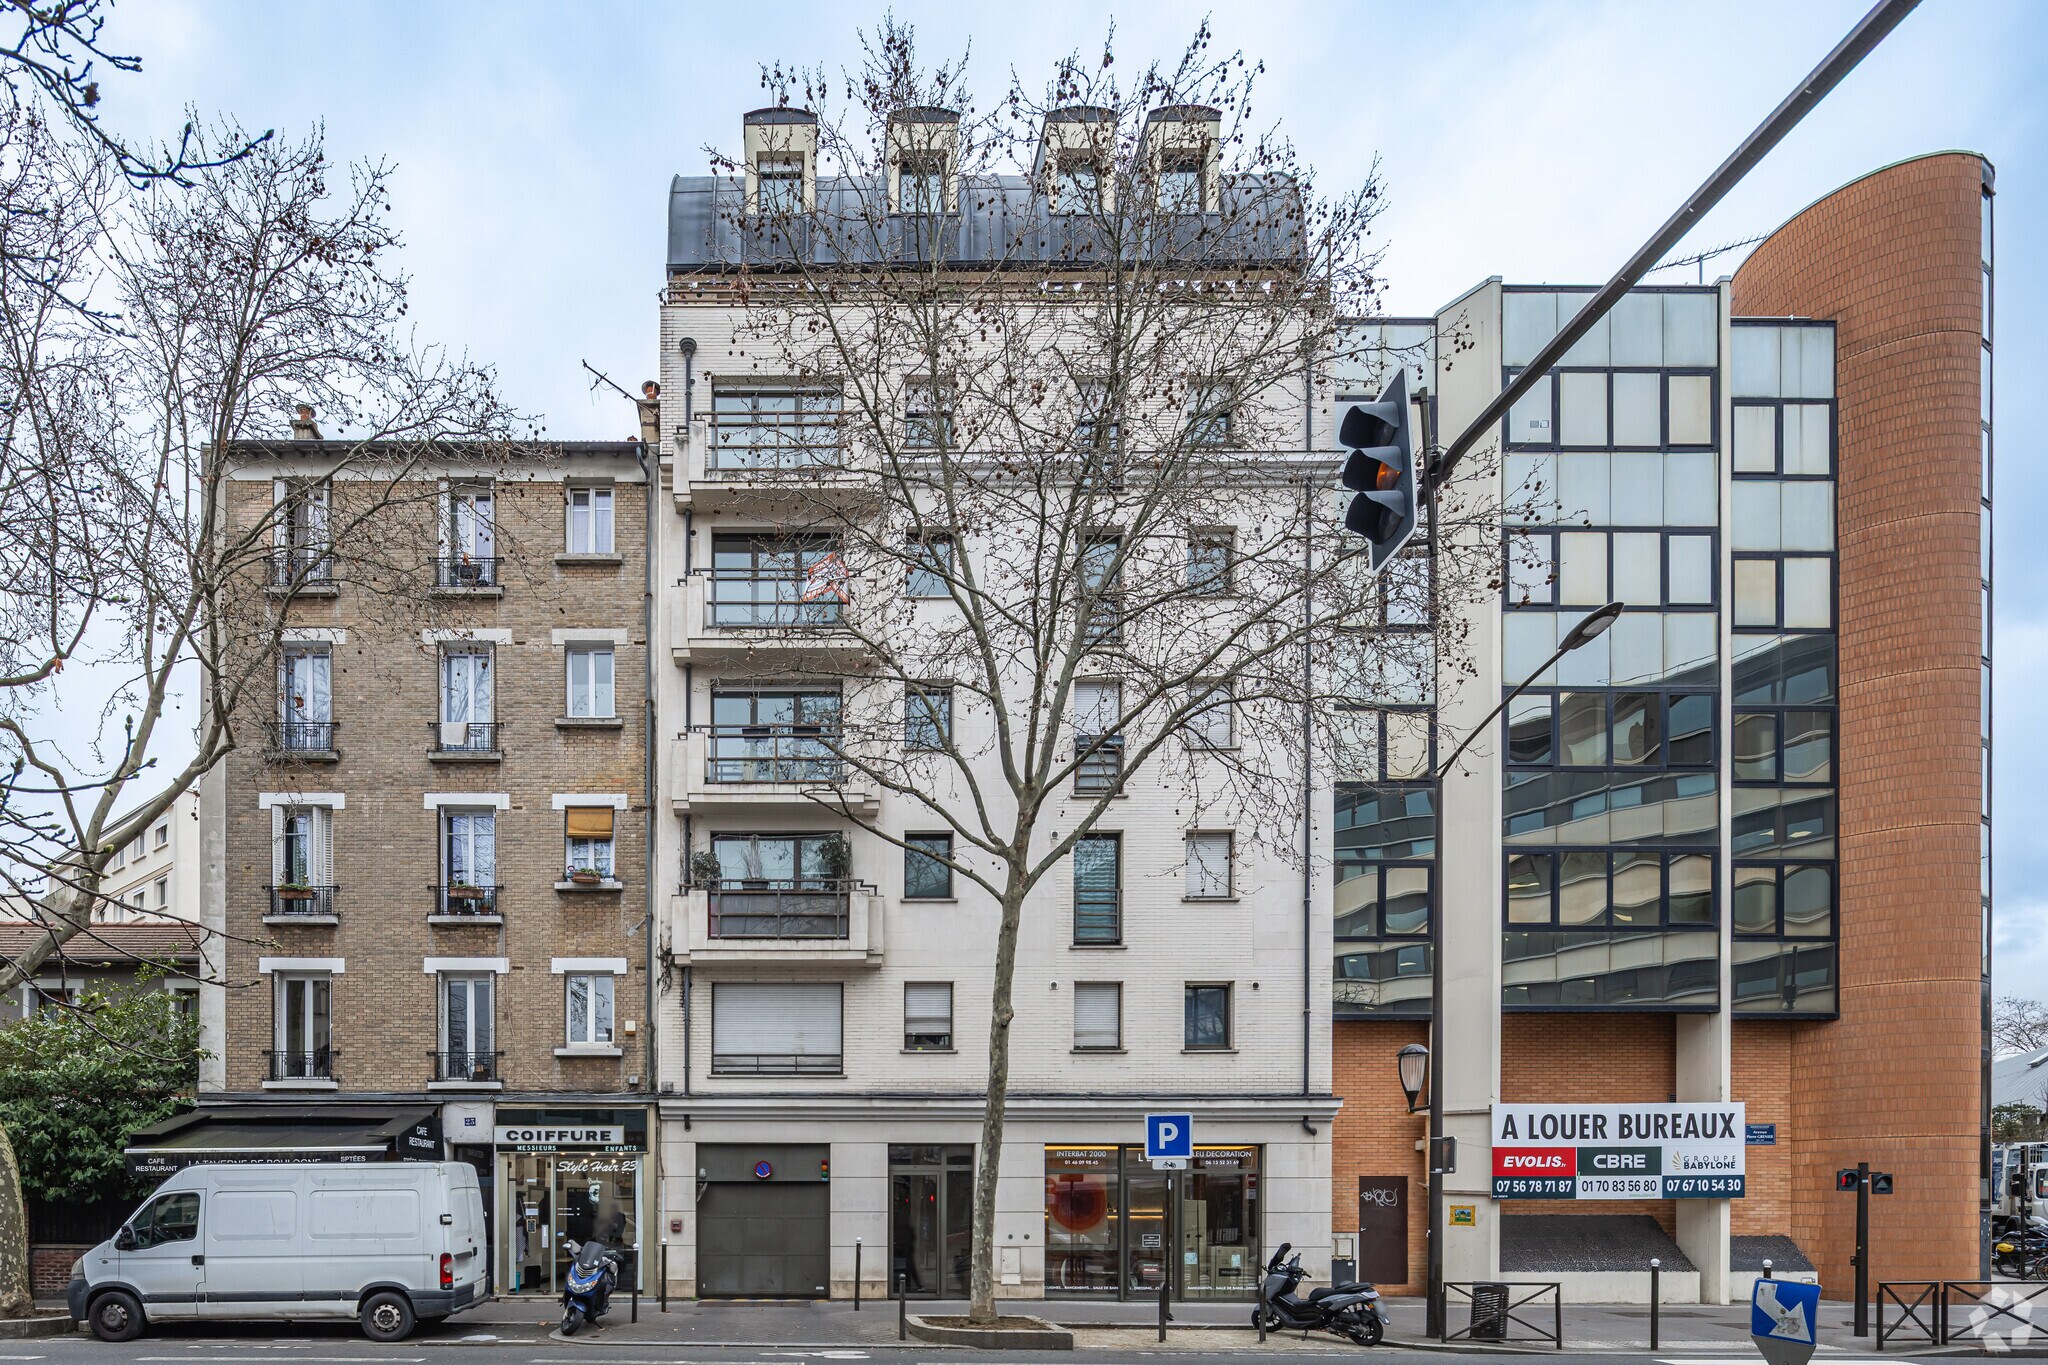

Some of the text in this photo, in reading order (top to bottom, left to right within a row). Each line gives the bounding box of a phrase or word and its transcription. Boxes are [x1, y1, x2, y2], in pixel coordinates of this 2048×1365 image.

[416, 1126, 428, 1136] CAFE
[1501, 1113, 1736, 1140] A LOUER BUREAUX
[506, 1130, 612, 1141] COIFFURE
[1158, 1122, 1179, 1150] P
[409, 1137, 435, 1149] RESTAURANT
[556, 1160, 638, 1175] Style Hair 23
[1593, 1154, 1646, 1169] CBRE
[1496, 1180, 1572, 1192] 07 56 78 71 87
[1581, 1180, 1657, 1192] 01 70 83 56 80
[1666, 1179, 1741, 1192] 07 67 10 54 30
